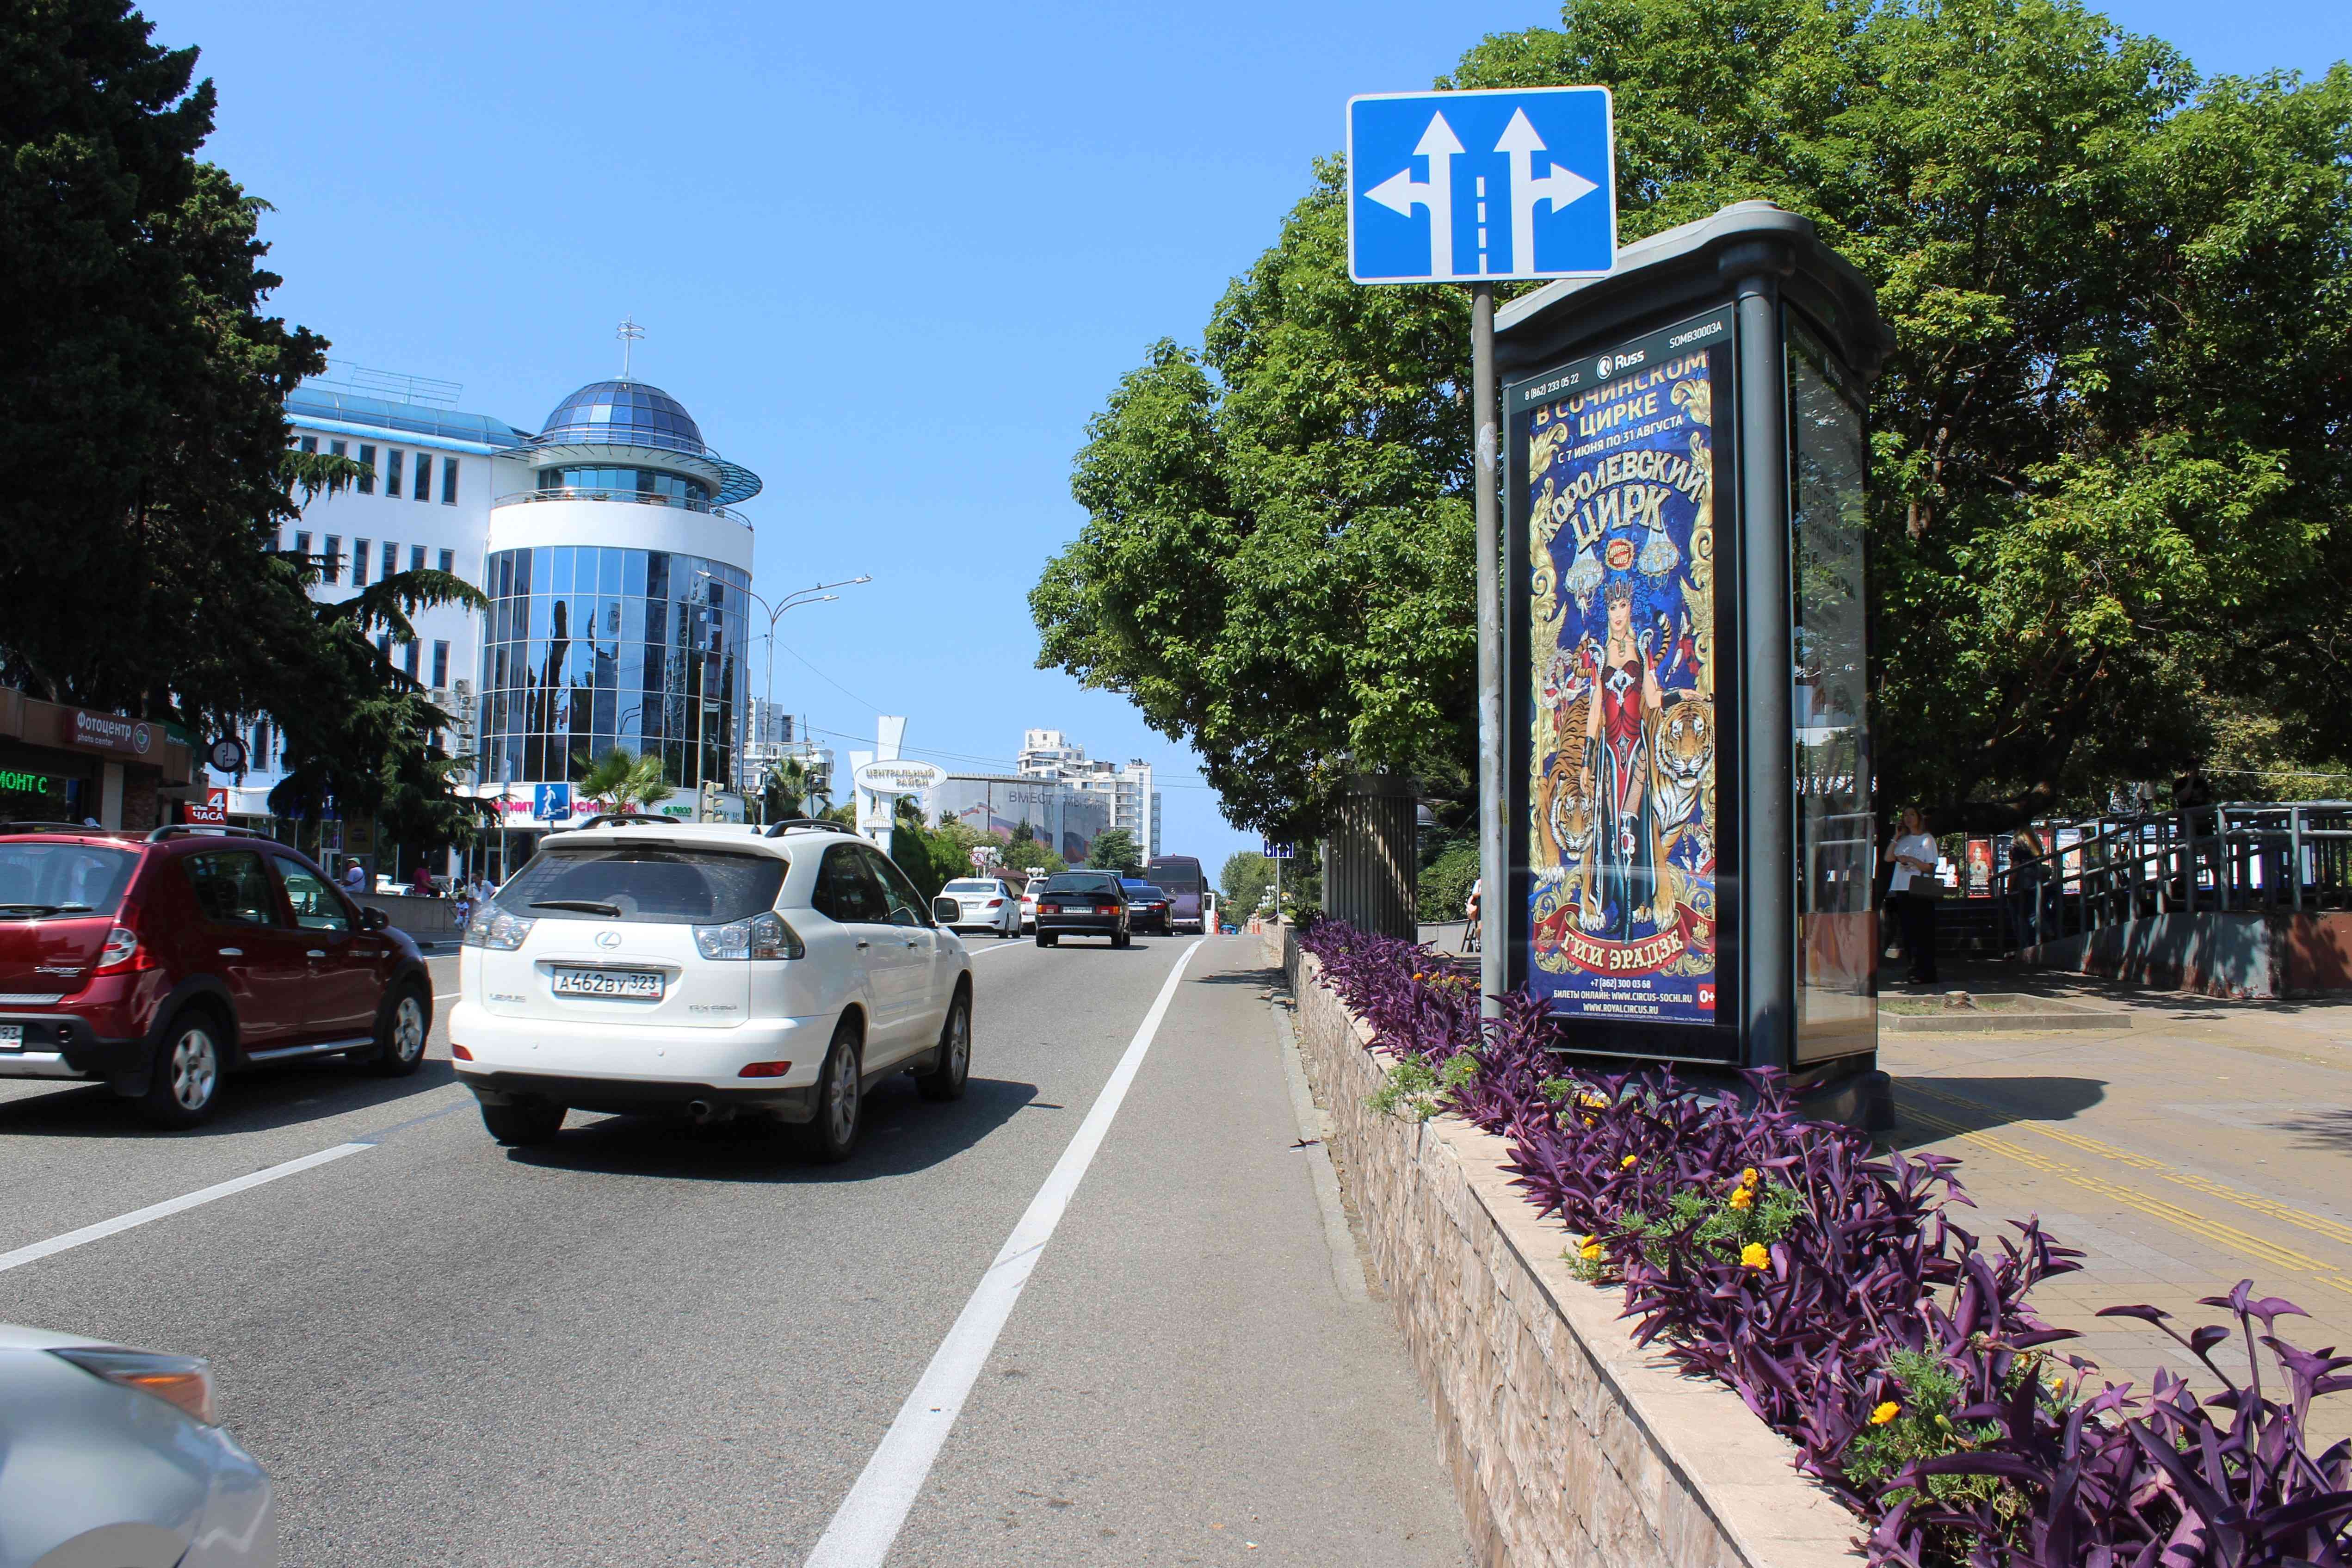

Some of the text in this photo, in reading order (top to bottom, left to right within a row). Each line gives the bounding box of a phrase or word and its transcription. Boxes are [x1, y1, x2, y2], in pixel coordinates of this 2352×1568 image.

[1615, 350, 1645, 370] Russ
[1525, 373, 1579, 401] 8 (862) 233 05 22
[1536, 350, 1707, 426] В СОЧИНСКОМ
[1580, 392, 1658, 438] ЦИРКЕ
[1557, 414, 1683, 464] С 7 ИЮНЯ ПО 31 АВГУСТА
[1539, 449, 1705, 543] КОРОЛЕВСКИЙ
[1569, 484, 1672, 554] ЦИРК
[1613, 553, 1629, 564] ШОУ
[77, 711, 131, 741] Фотоцентр
[77, 733, 114, 746] photo center
[866, 768, 935, 780] ЦЕНТРАЛЬНЫЙ
[896, 777, 929, 788] РАЙОН
[192, 792, 225, 811] 4
[1009, 790, 1059, 806] ВМЕСТ
[192, 811, 224, 821] ЧАСА
[1561, 929, 1684, 970] ГИИ ЭРАДЗЕ
[560, 973, 656, 993] А462ВУ 323
[1599, 977, 1617, 990] (862)
[1617, 979, 1631, 988] 300
[1632, 979, 1641, 988] 03
[1642, 980, 1651, 989] 68
[1553, 989, 1692, 1003] БИЛЕТЫ ОНЛАЙН: WWW.CIRCUS-SOCHI.RU
[1699, 990, 1715, 1003] 0+
[1583, 1003, 1659, 1014] WWW.ROYALCIRCUS.RU
